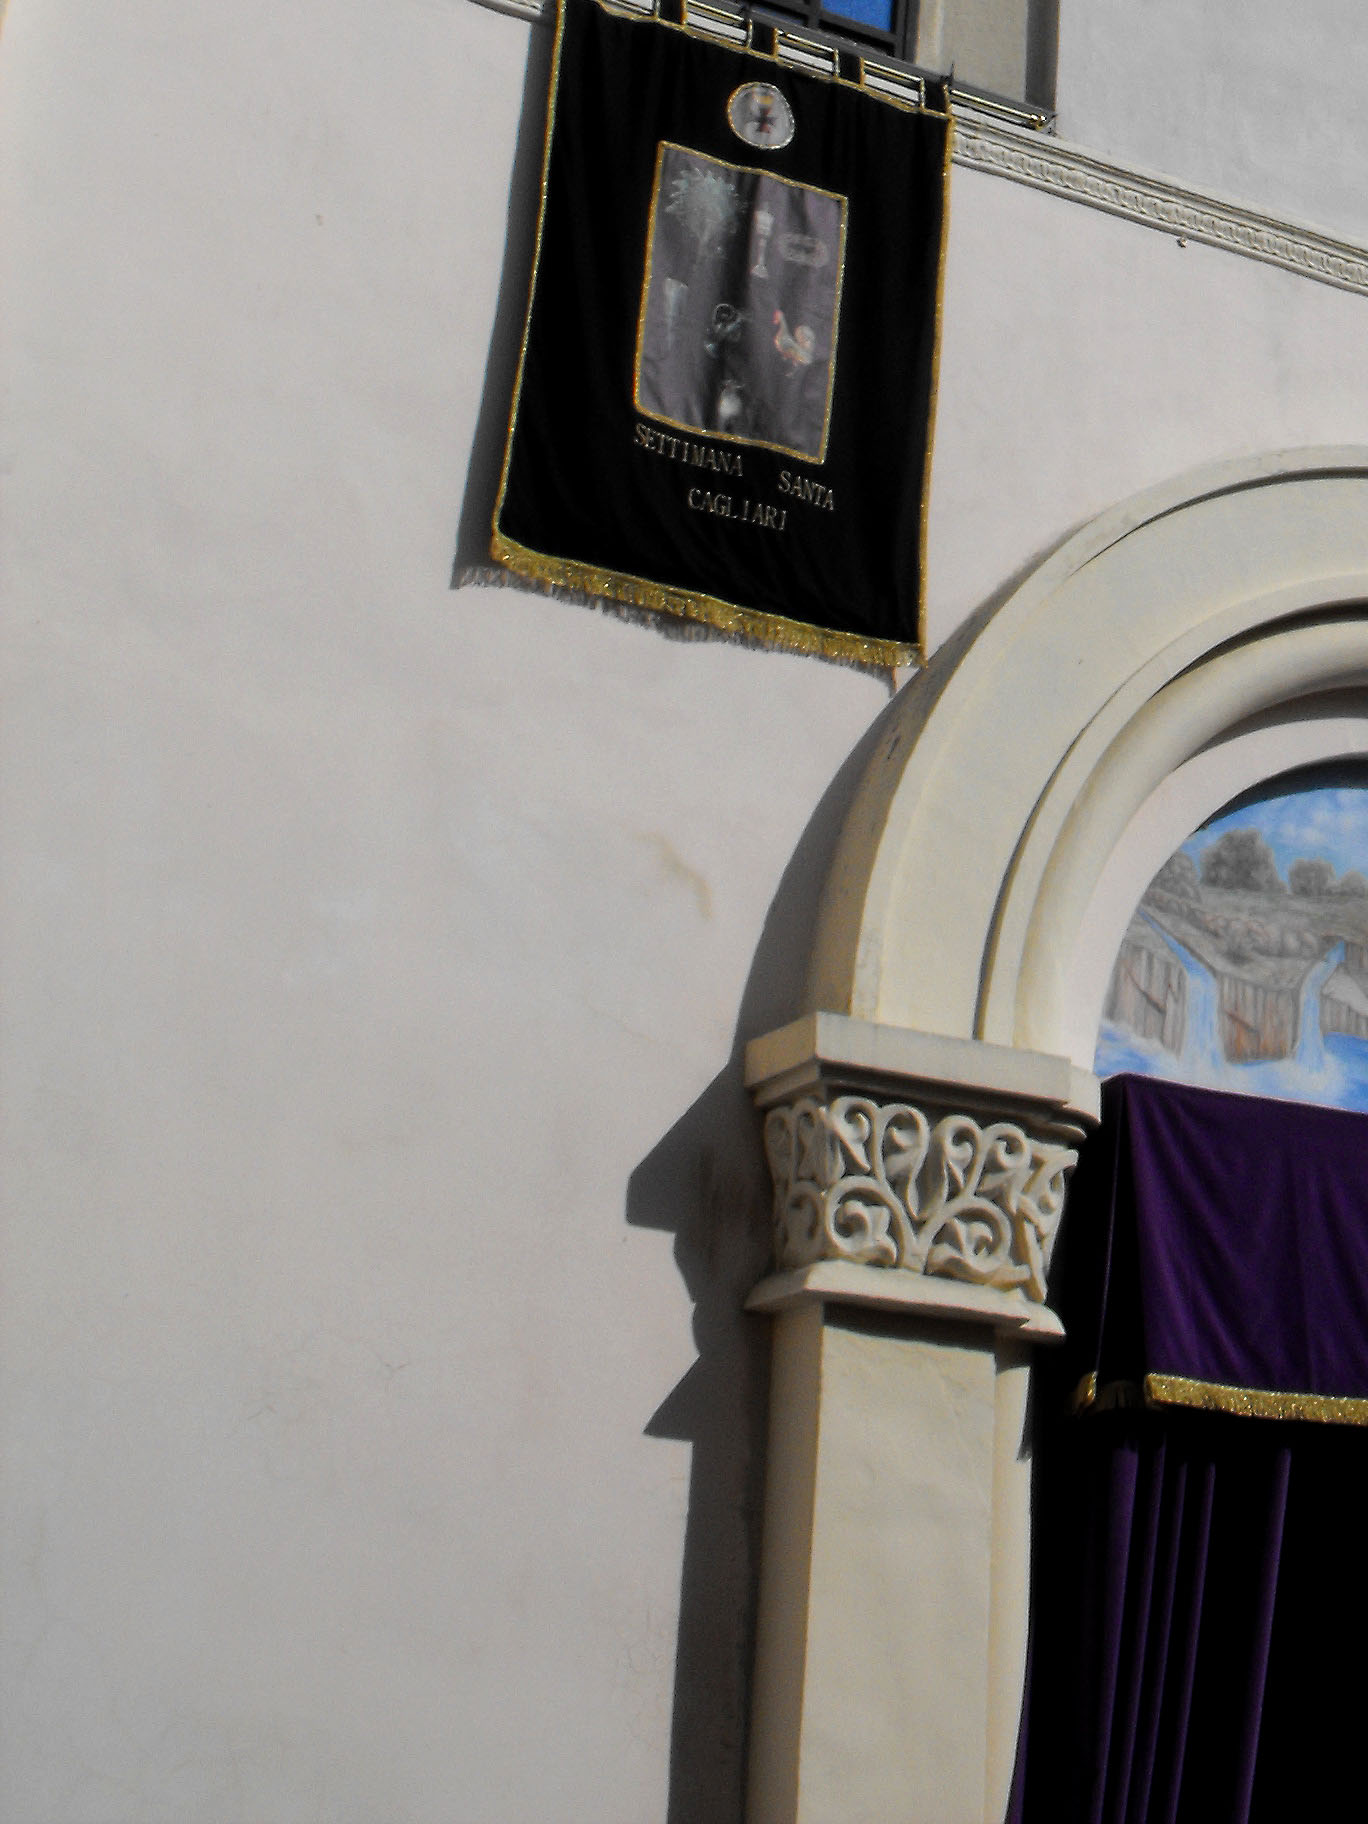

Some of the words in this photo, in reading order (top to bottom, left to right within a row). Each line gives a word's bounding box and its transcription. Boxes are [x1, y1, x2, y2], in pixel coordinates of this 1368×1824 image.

[633, 422, 743, 477] SETTIMANA
[777, 470, 835, 511] SANTA
[687, 487, 788, 531] CAGLIARI
